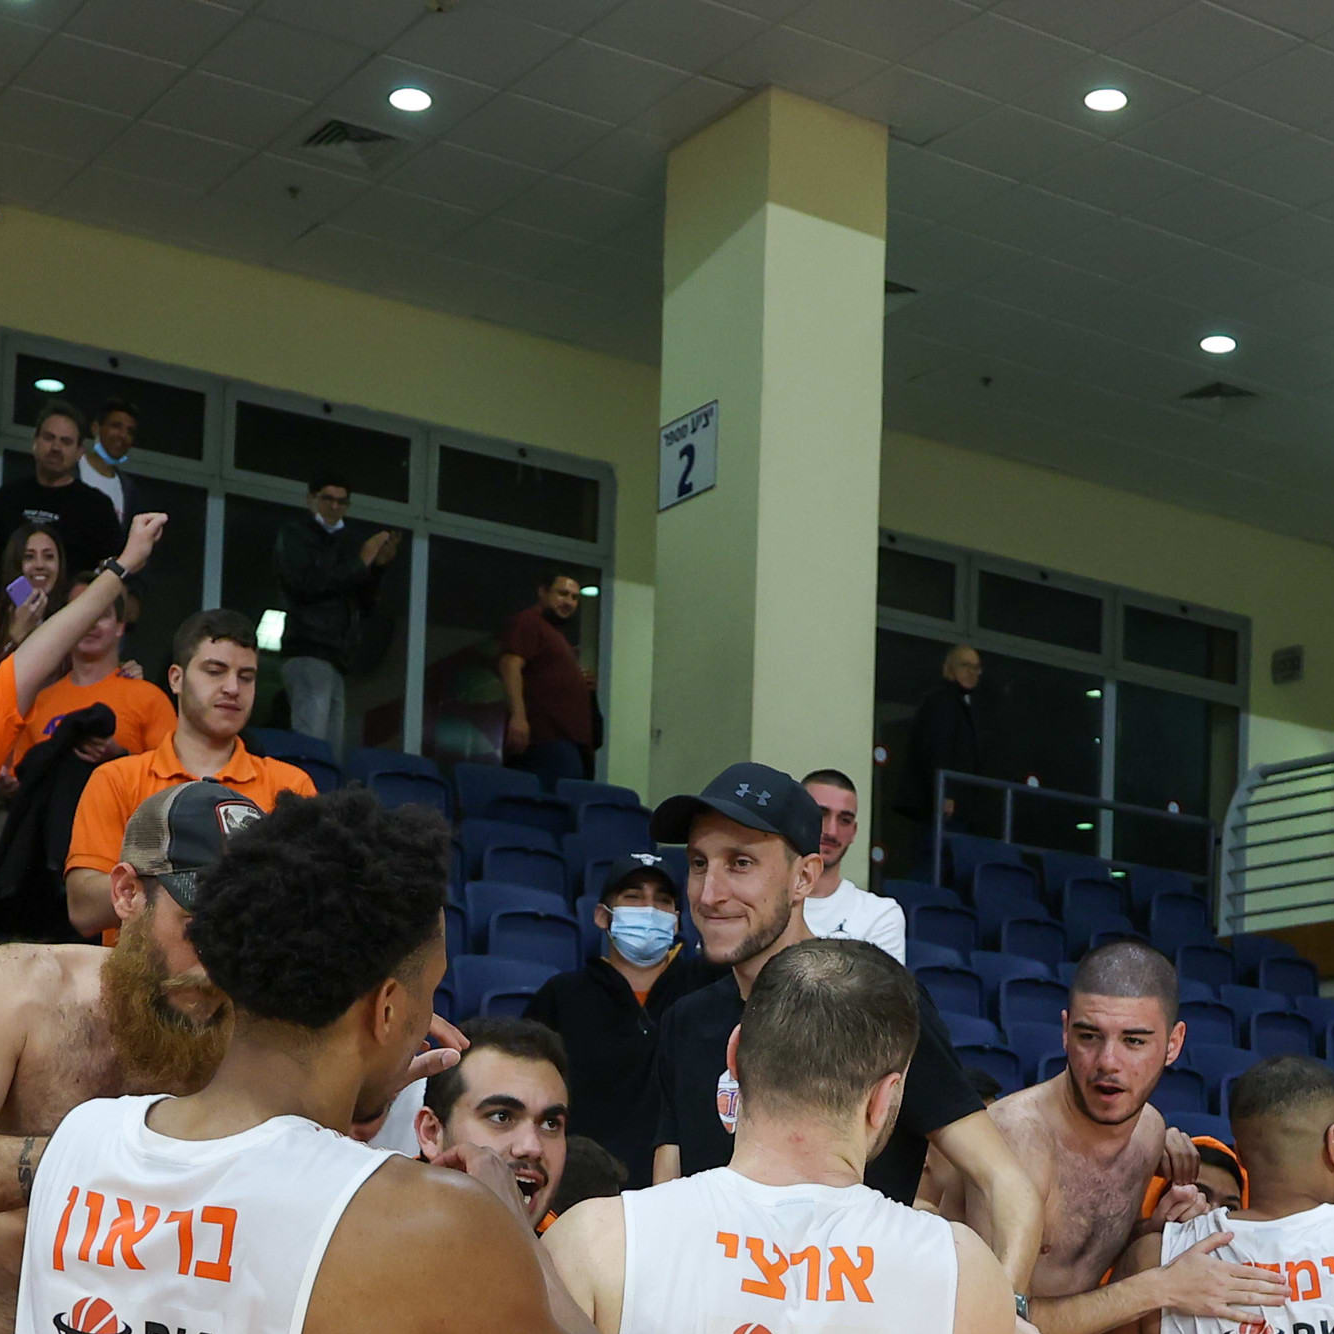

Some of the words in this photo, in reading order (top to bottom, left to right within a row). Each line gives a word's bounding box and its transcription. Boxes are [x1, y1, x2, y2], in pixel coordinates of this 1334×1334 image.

[678, 443, 695, 498] 2
[53, 1186, 237, 1283] בראון
[716, 1231, 874, 1303] ארצי
